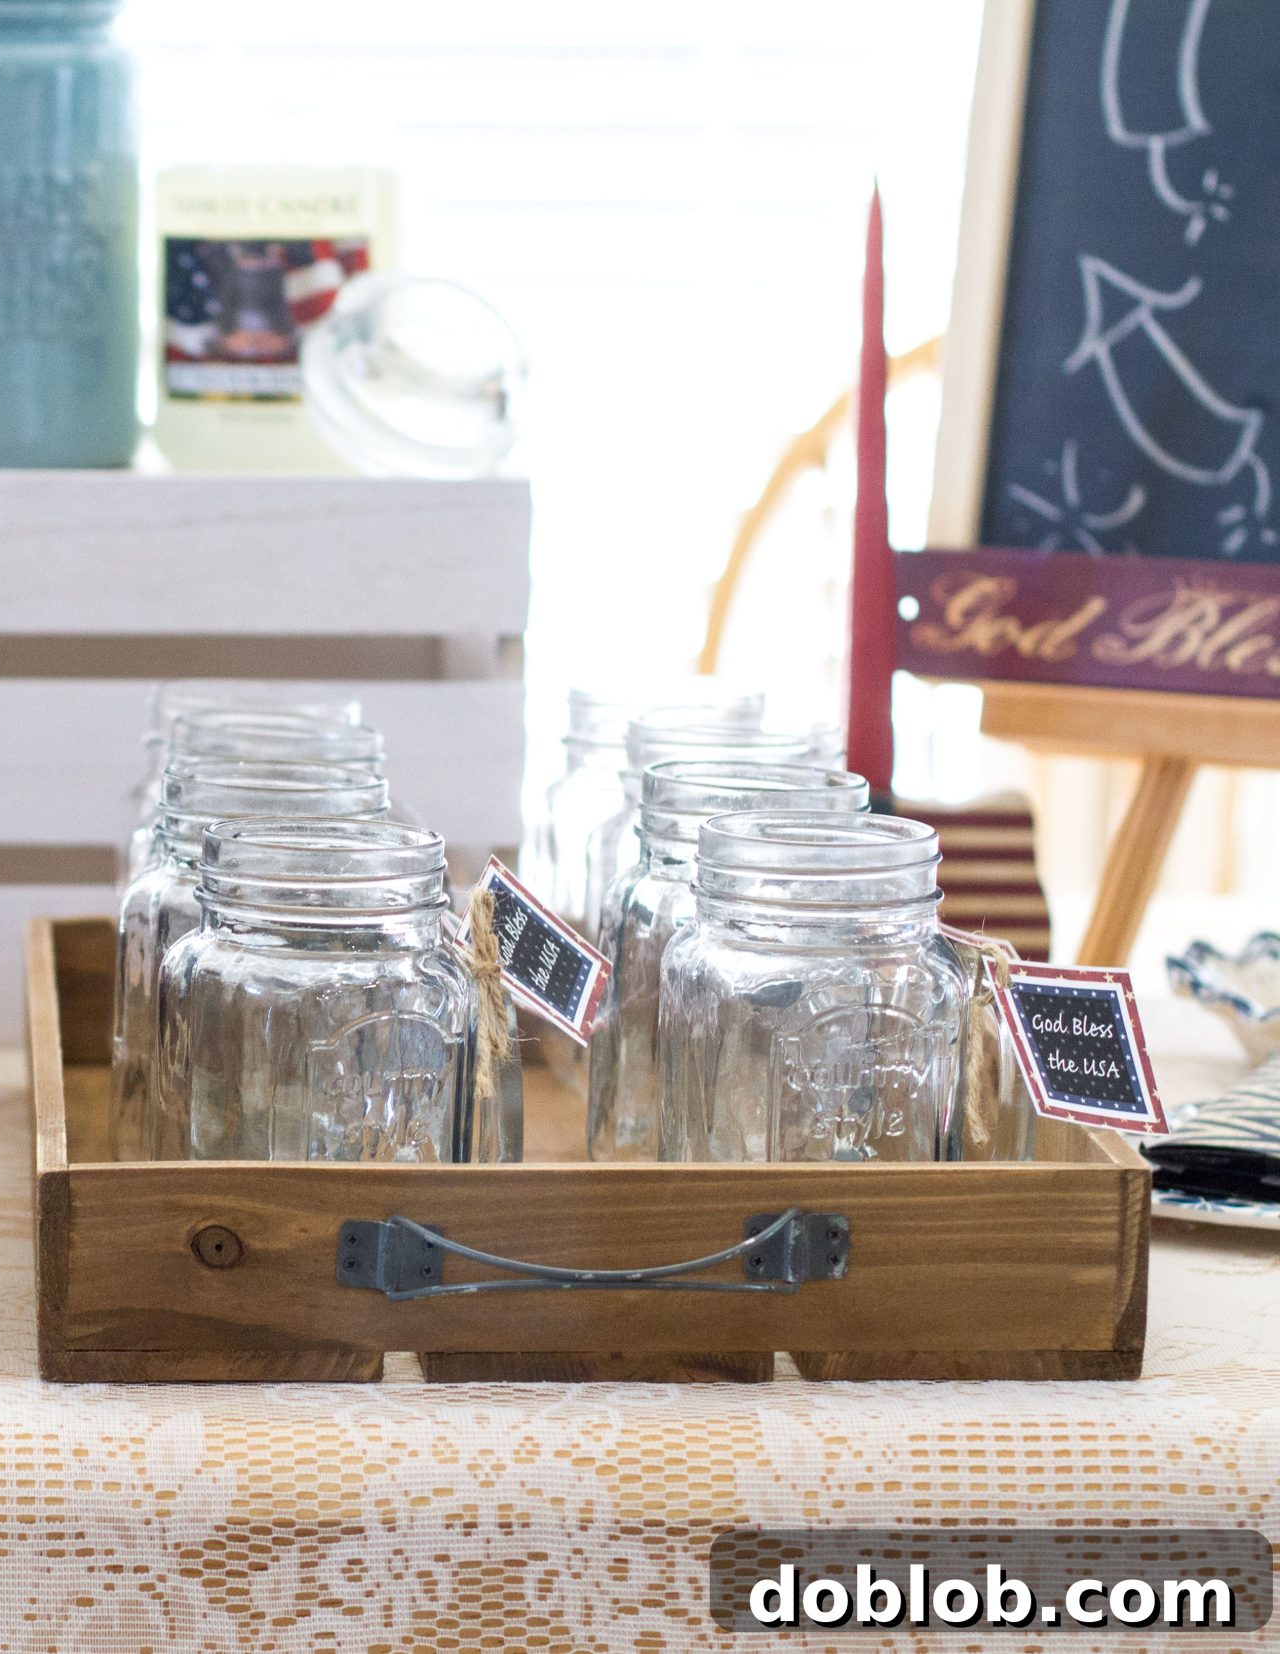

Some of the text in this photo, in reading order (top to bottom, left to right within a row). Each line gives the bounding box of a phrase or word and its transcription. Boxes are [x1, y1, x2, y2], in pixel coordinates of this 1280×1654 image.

[911, 572, 1107, 662] God
[505, 906, 529, 942] Bless
[528, 937, 561, 991] the USA
[1032, 1012, 1114, 1040] God Bless
[1047, 1049, 1120, 1079] the USA
